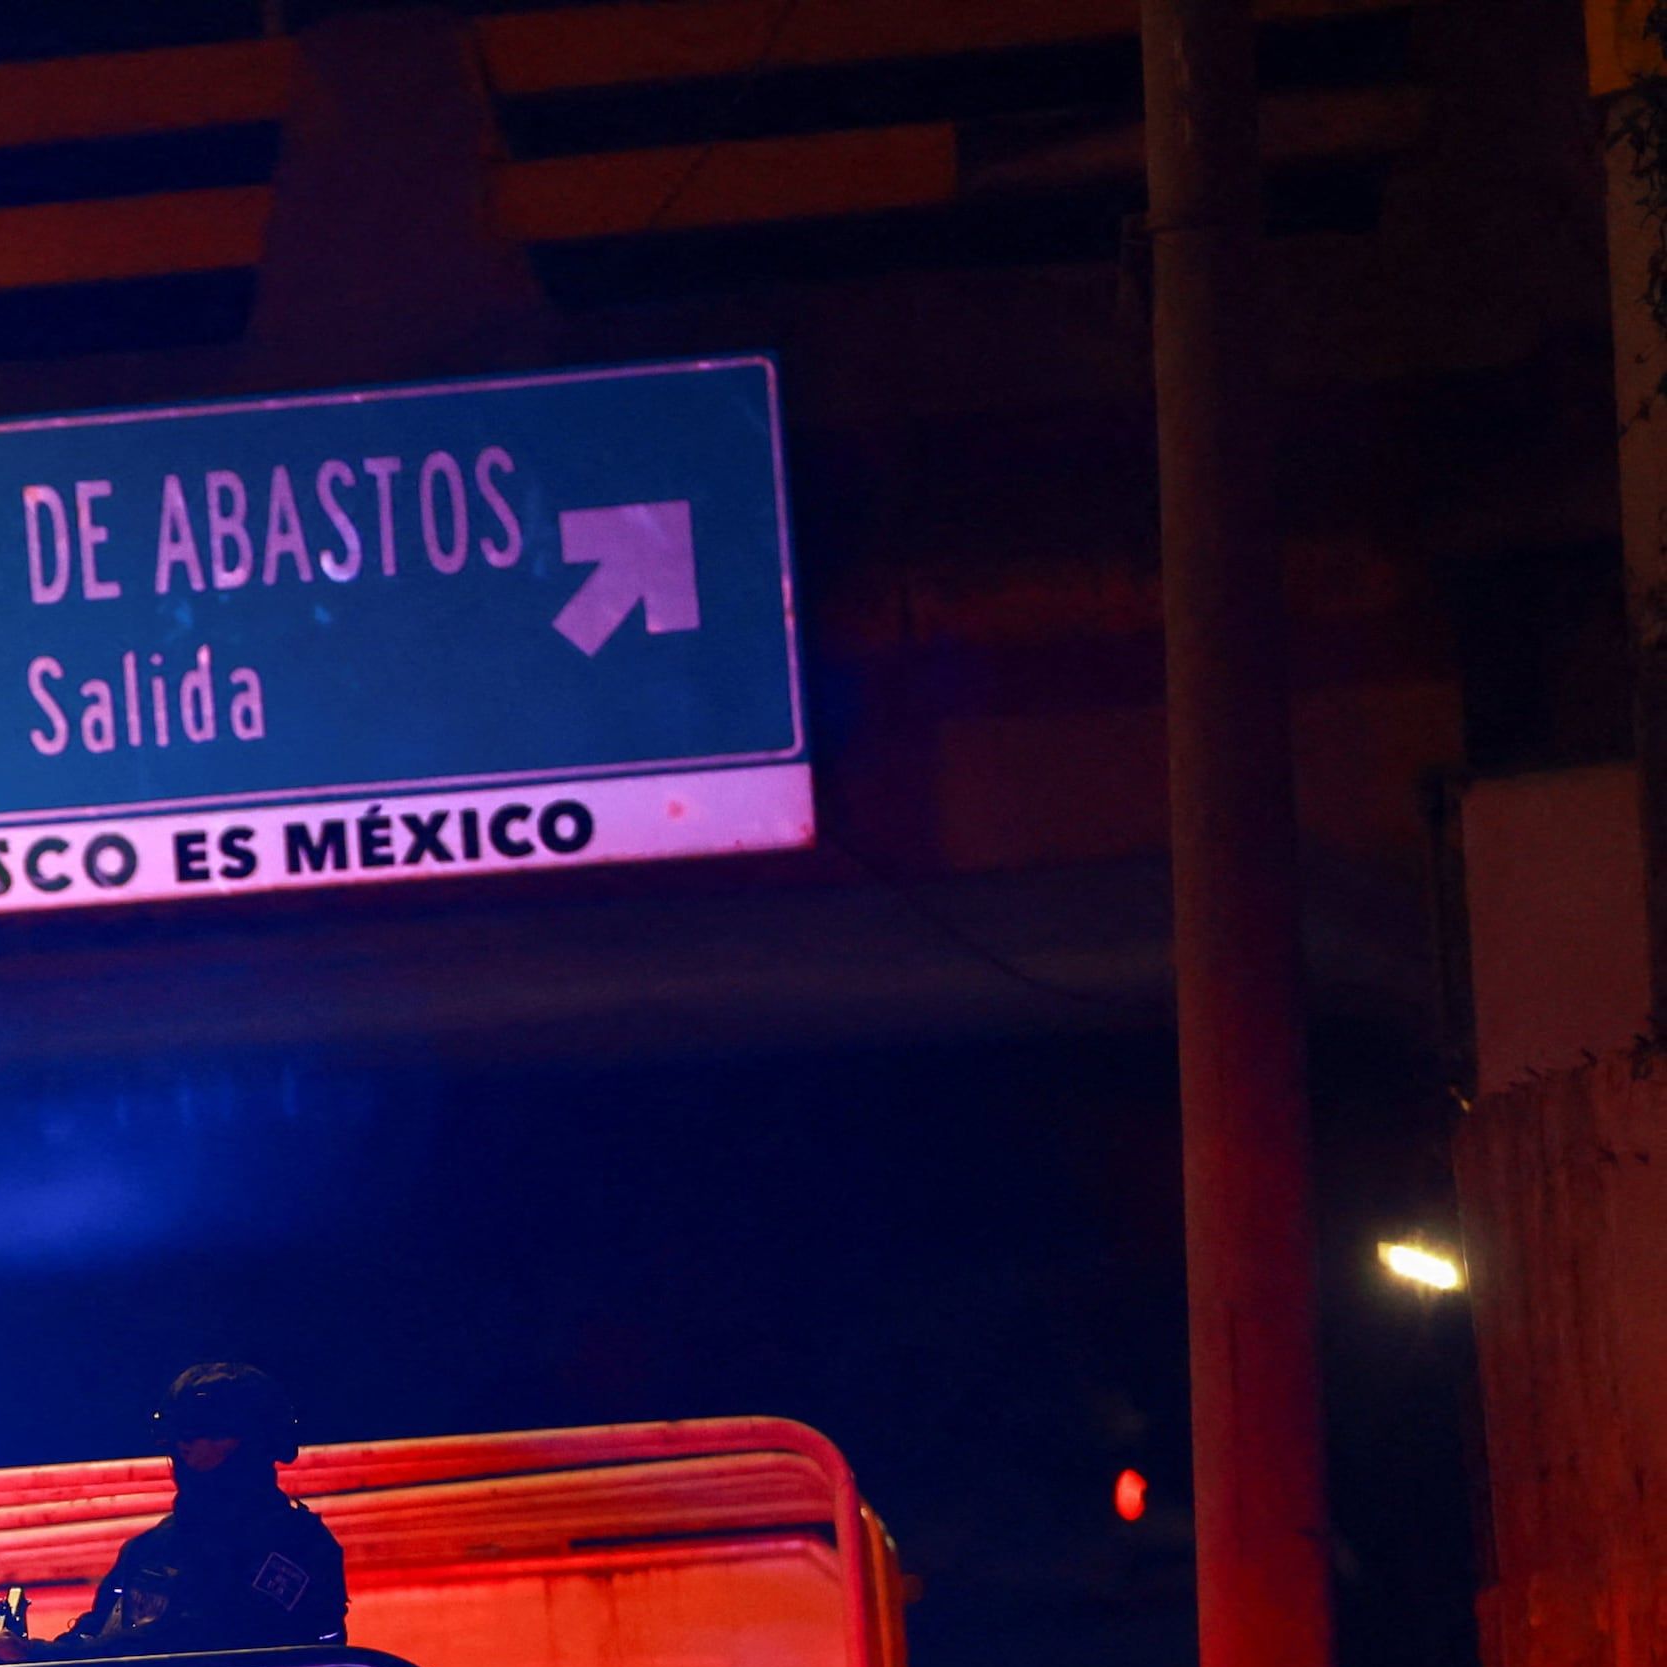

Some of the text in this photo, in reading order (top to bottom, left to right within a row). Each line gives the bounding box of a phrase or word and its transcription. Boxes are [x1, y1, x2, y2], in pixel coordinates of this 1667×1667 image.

[22, 480, 121, 605] DE
[155, 446, 523, 595] ABASTOS
[27, 644, 265, 756] Salida
[174, 826, 258, 882] ES
[285, 798, 594, 874] MÉXICO
